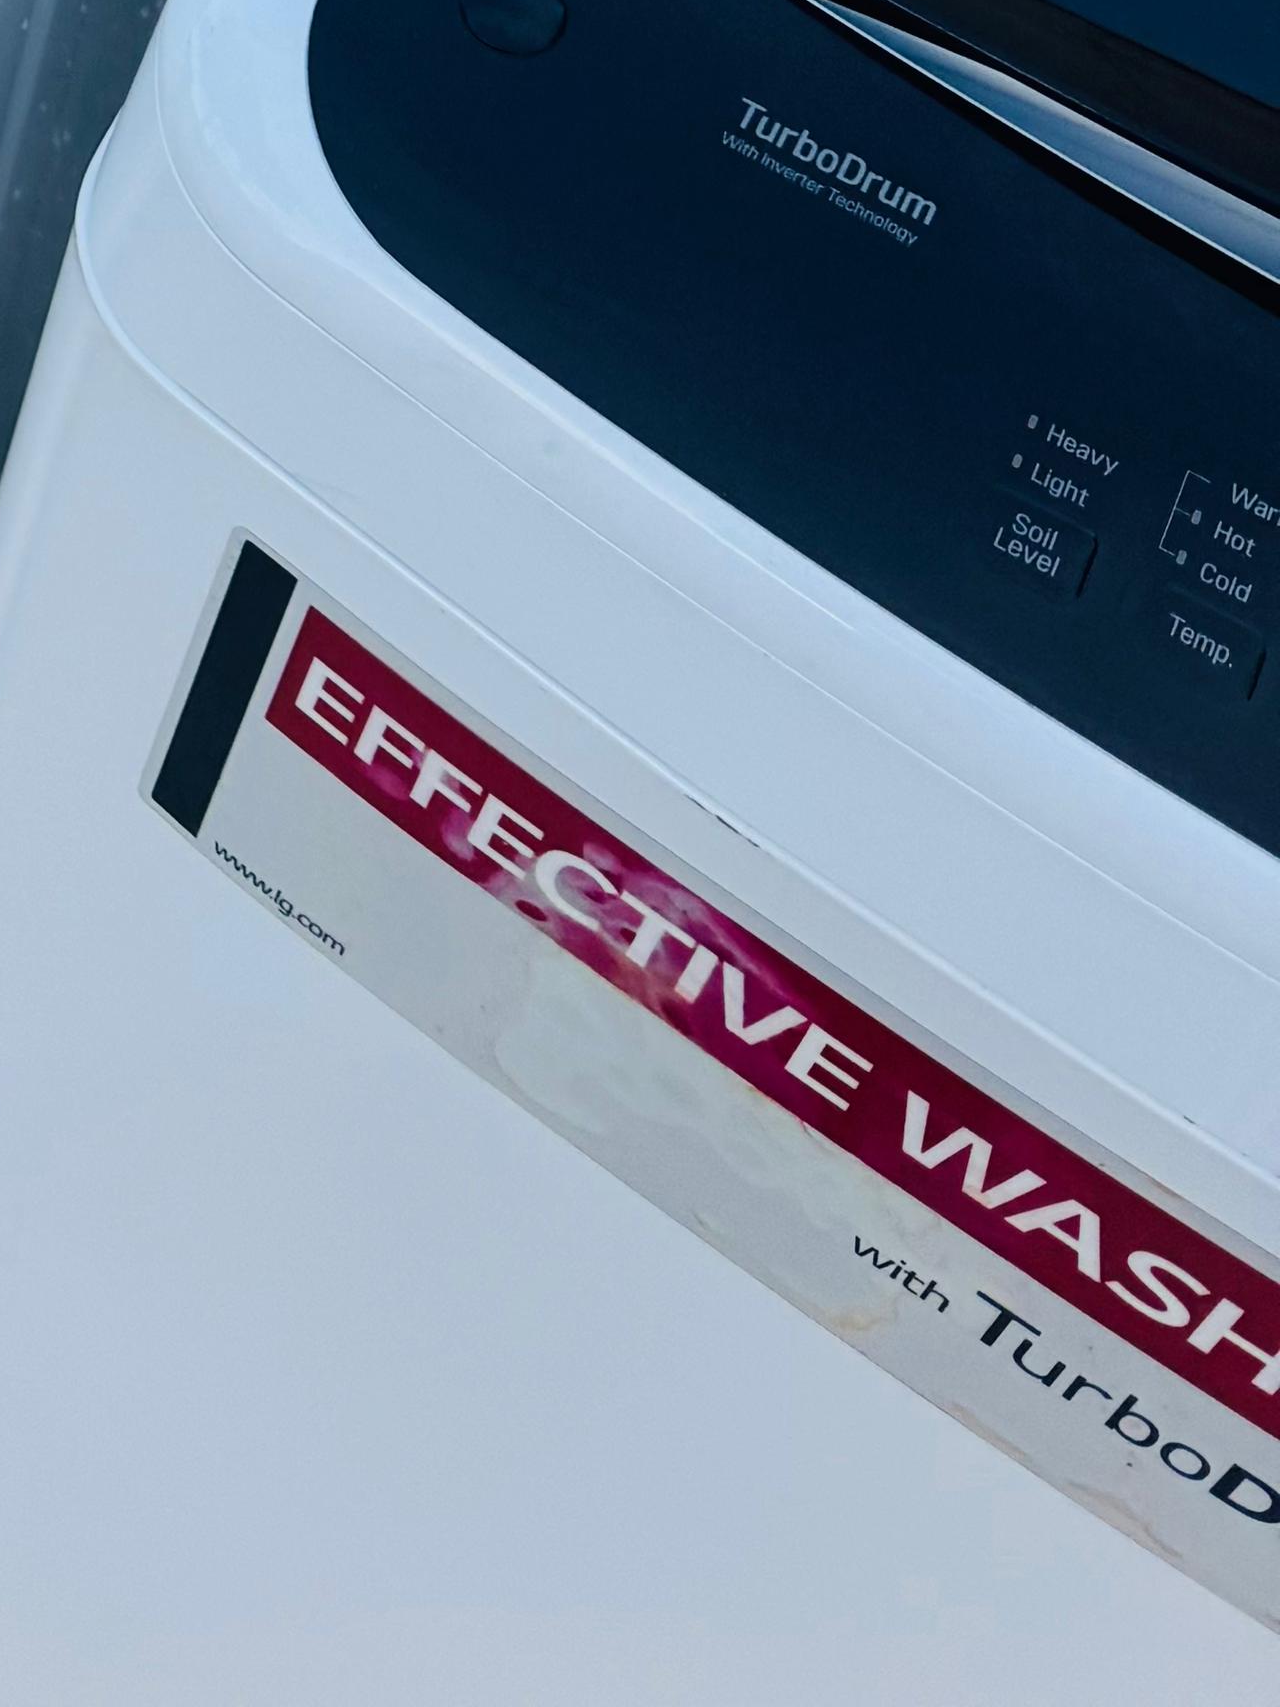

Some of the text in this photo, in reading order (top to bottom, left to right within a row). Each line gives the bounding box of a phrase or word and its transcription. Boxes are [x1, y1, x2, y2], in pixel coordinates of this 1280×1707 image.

[739, 97, 937, 226] TurboDrum
[722, 130, 918, 248] With Inverter Technology
[1046, 423, 1119, 477] Heavy
[1030, 462, 1090, 508] Light
[1232, 482, 1280, 527] War
[993, 525, 1060, 577] Level
[1012, 511, 1058, 550] Soil
[1213, 520, 1255, 557] Hot
[1198, 562, 1252, 603] Cold
[1168, 613, 1233, 668] Temp.
[213, 838, 348, 957] www.lg.com
[294, 656, 1280, 1395] EFFECTIVE WASH
[851, 1235, 951, 1313] with
